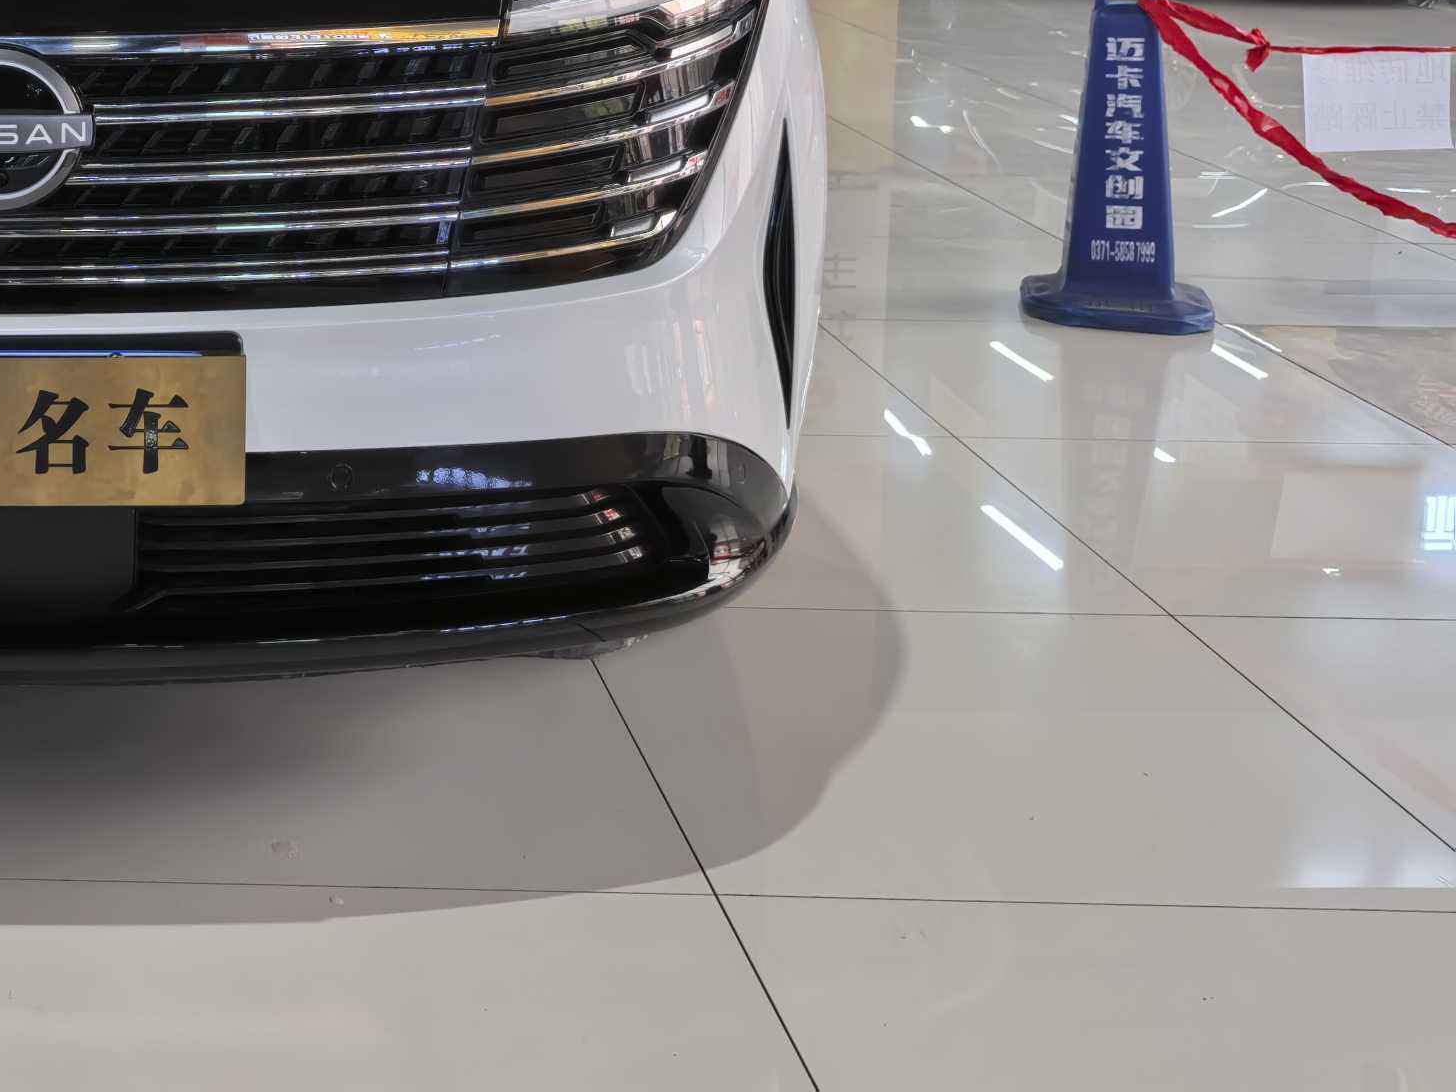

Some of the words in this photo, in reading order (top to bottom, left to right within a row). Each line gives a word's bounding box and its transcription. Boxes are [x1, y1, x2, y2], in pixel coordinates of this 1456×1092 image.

[1104, 37, 1146, 230] 迈卡汽车文创园
